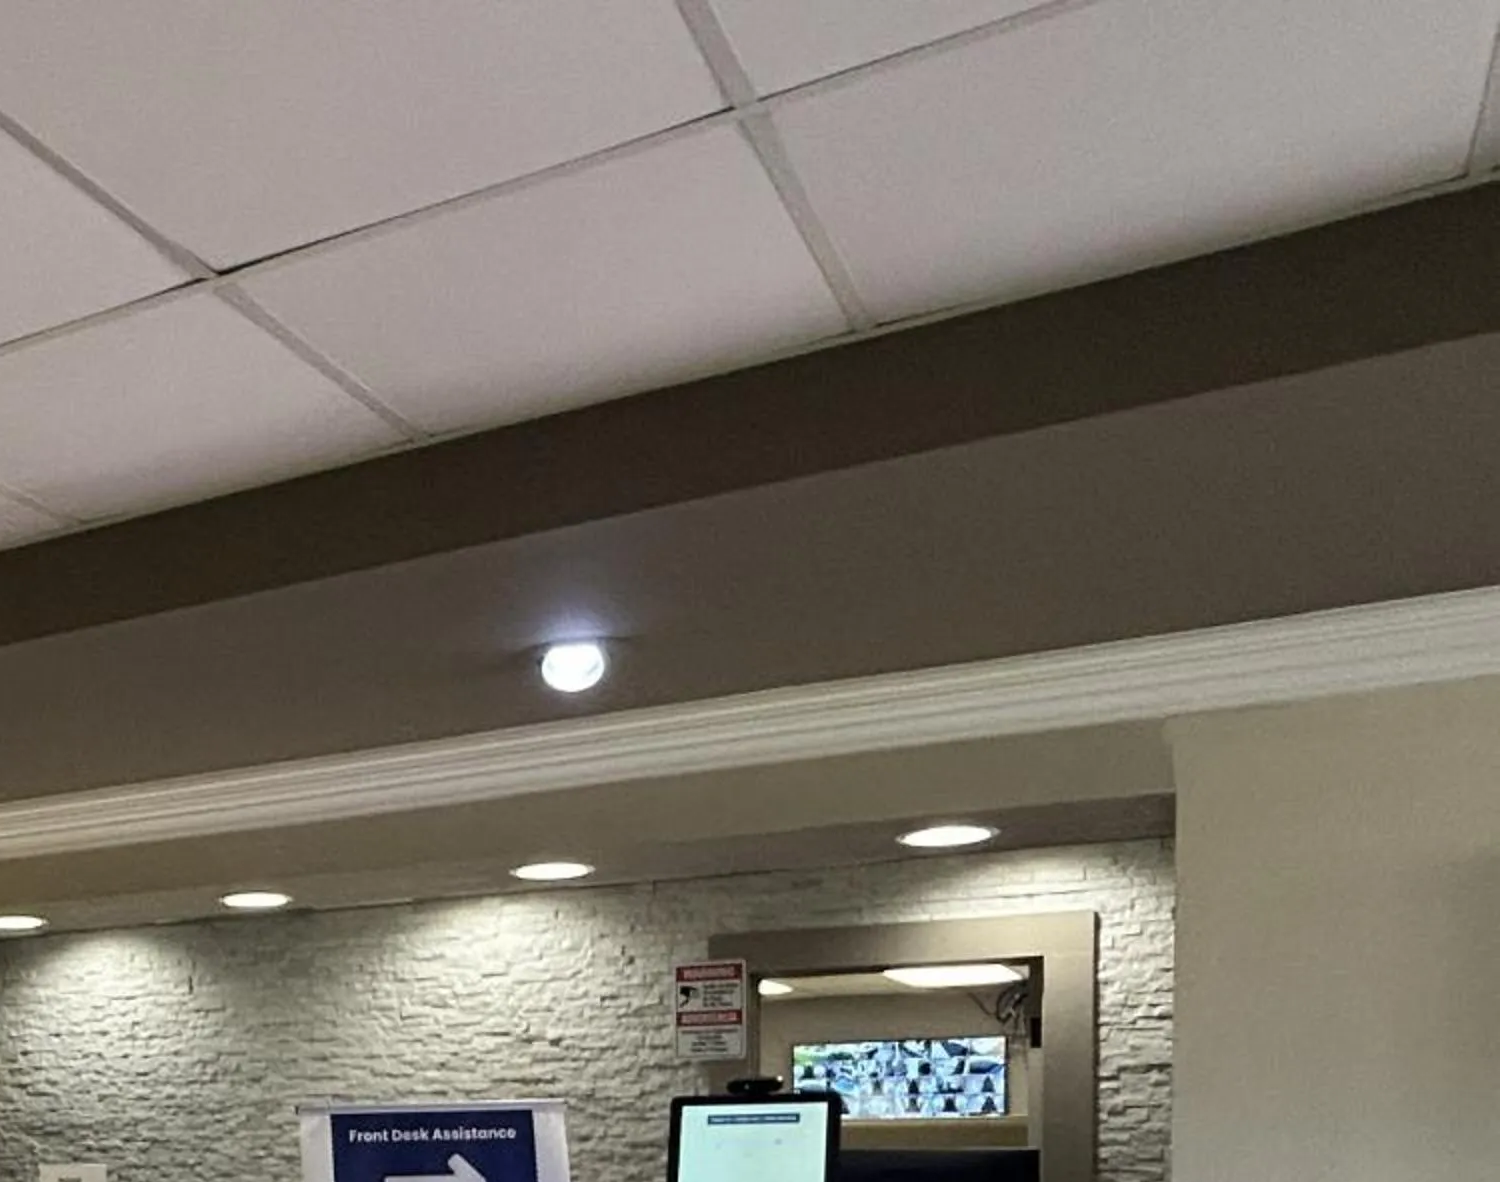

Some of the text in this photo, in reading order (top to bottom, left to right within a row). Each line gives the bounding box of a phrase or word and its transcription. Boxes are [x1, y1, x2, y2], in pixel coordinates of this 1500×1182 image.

[349, 1126, 517, 1142] Front Desk Assistance
